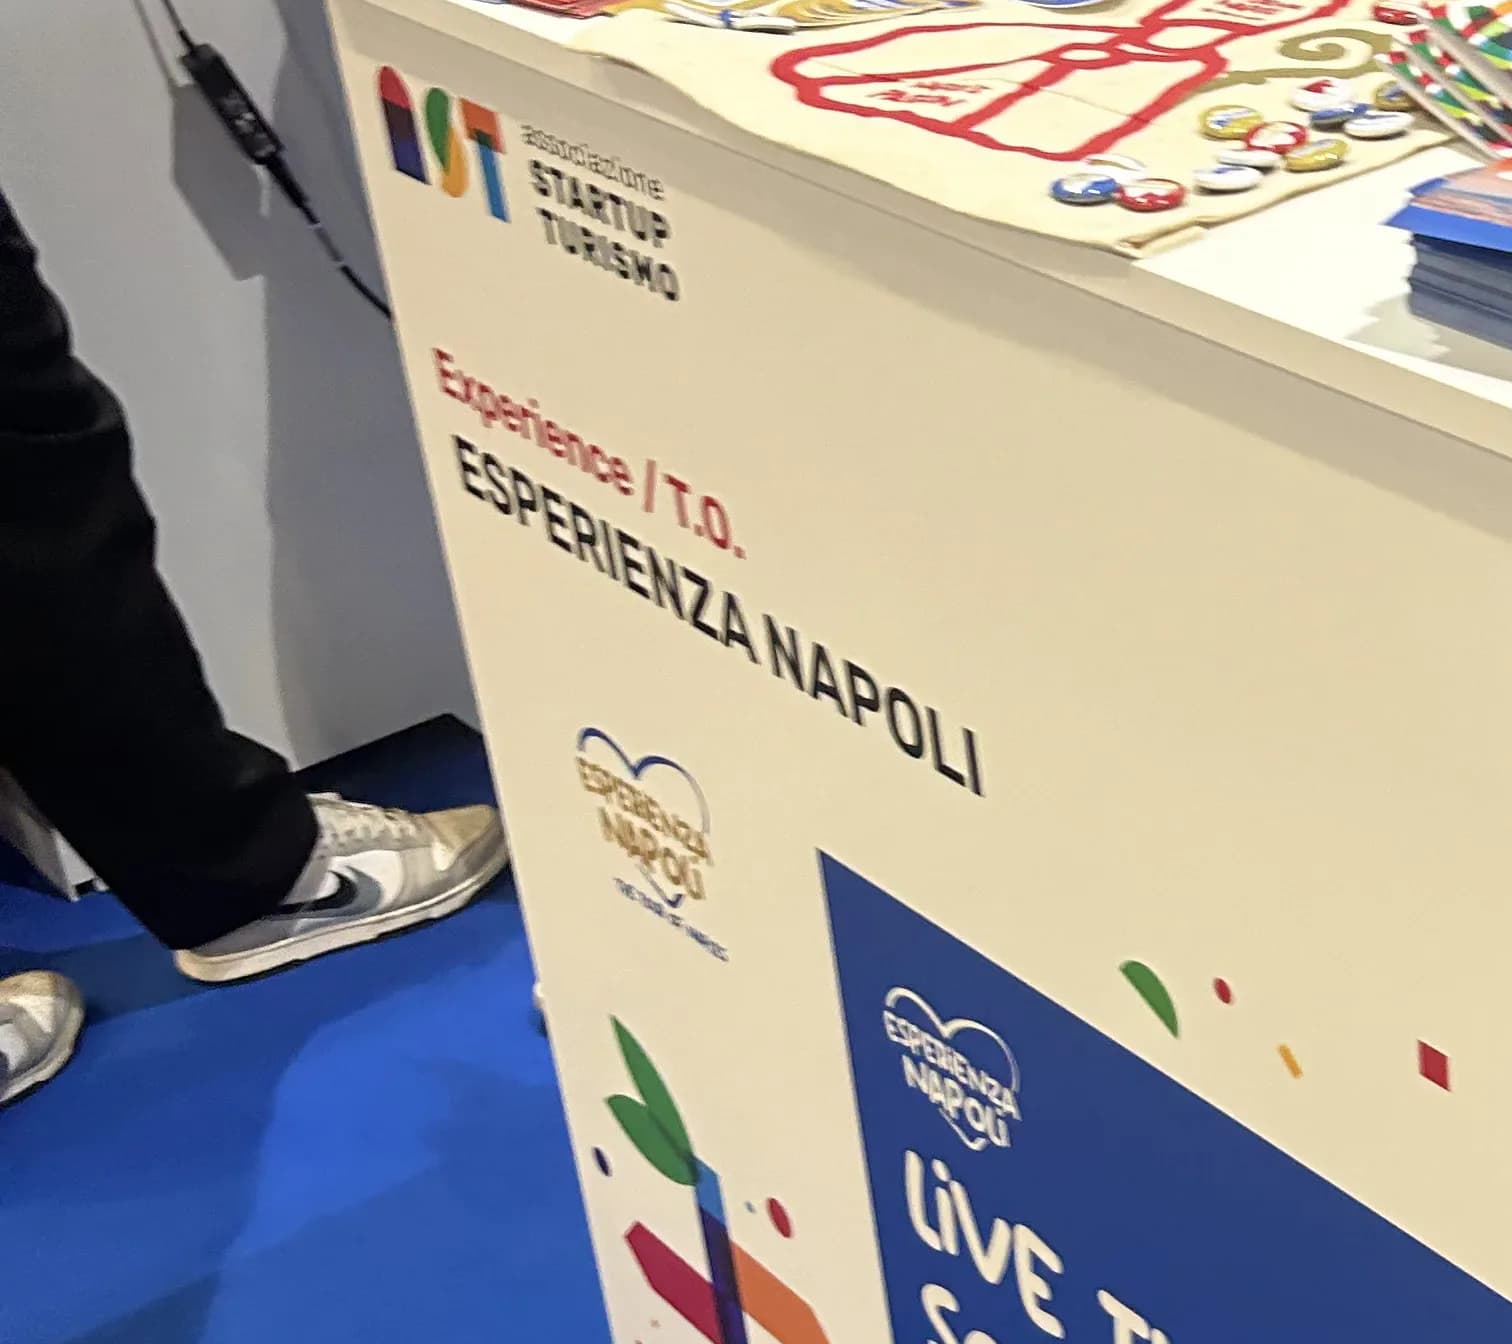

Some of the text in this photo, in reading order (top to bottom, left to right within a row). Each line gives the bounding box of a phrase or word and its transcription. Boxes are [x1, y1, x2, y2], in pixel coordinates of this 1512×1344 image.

[529, 158, 672, 249] STARTUP
[535, 206, 681, 302] TURISMO
[431, 346, 747, 560] Experience / T.O.
[451, 434, 987, 799] ESPERIENZA NAPOLI
[883, 1009, 1023, 1122] ESPERIENZA
